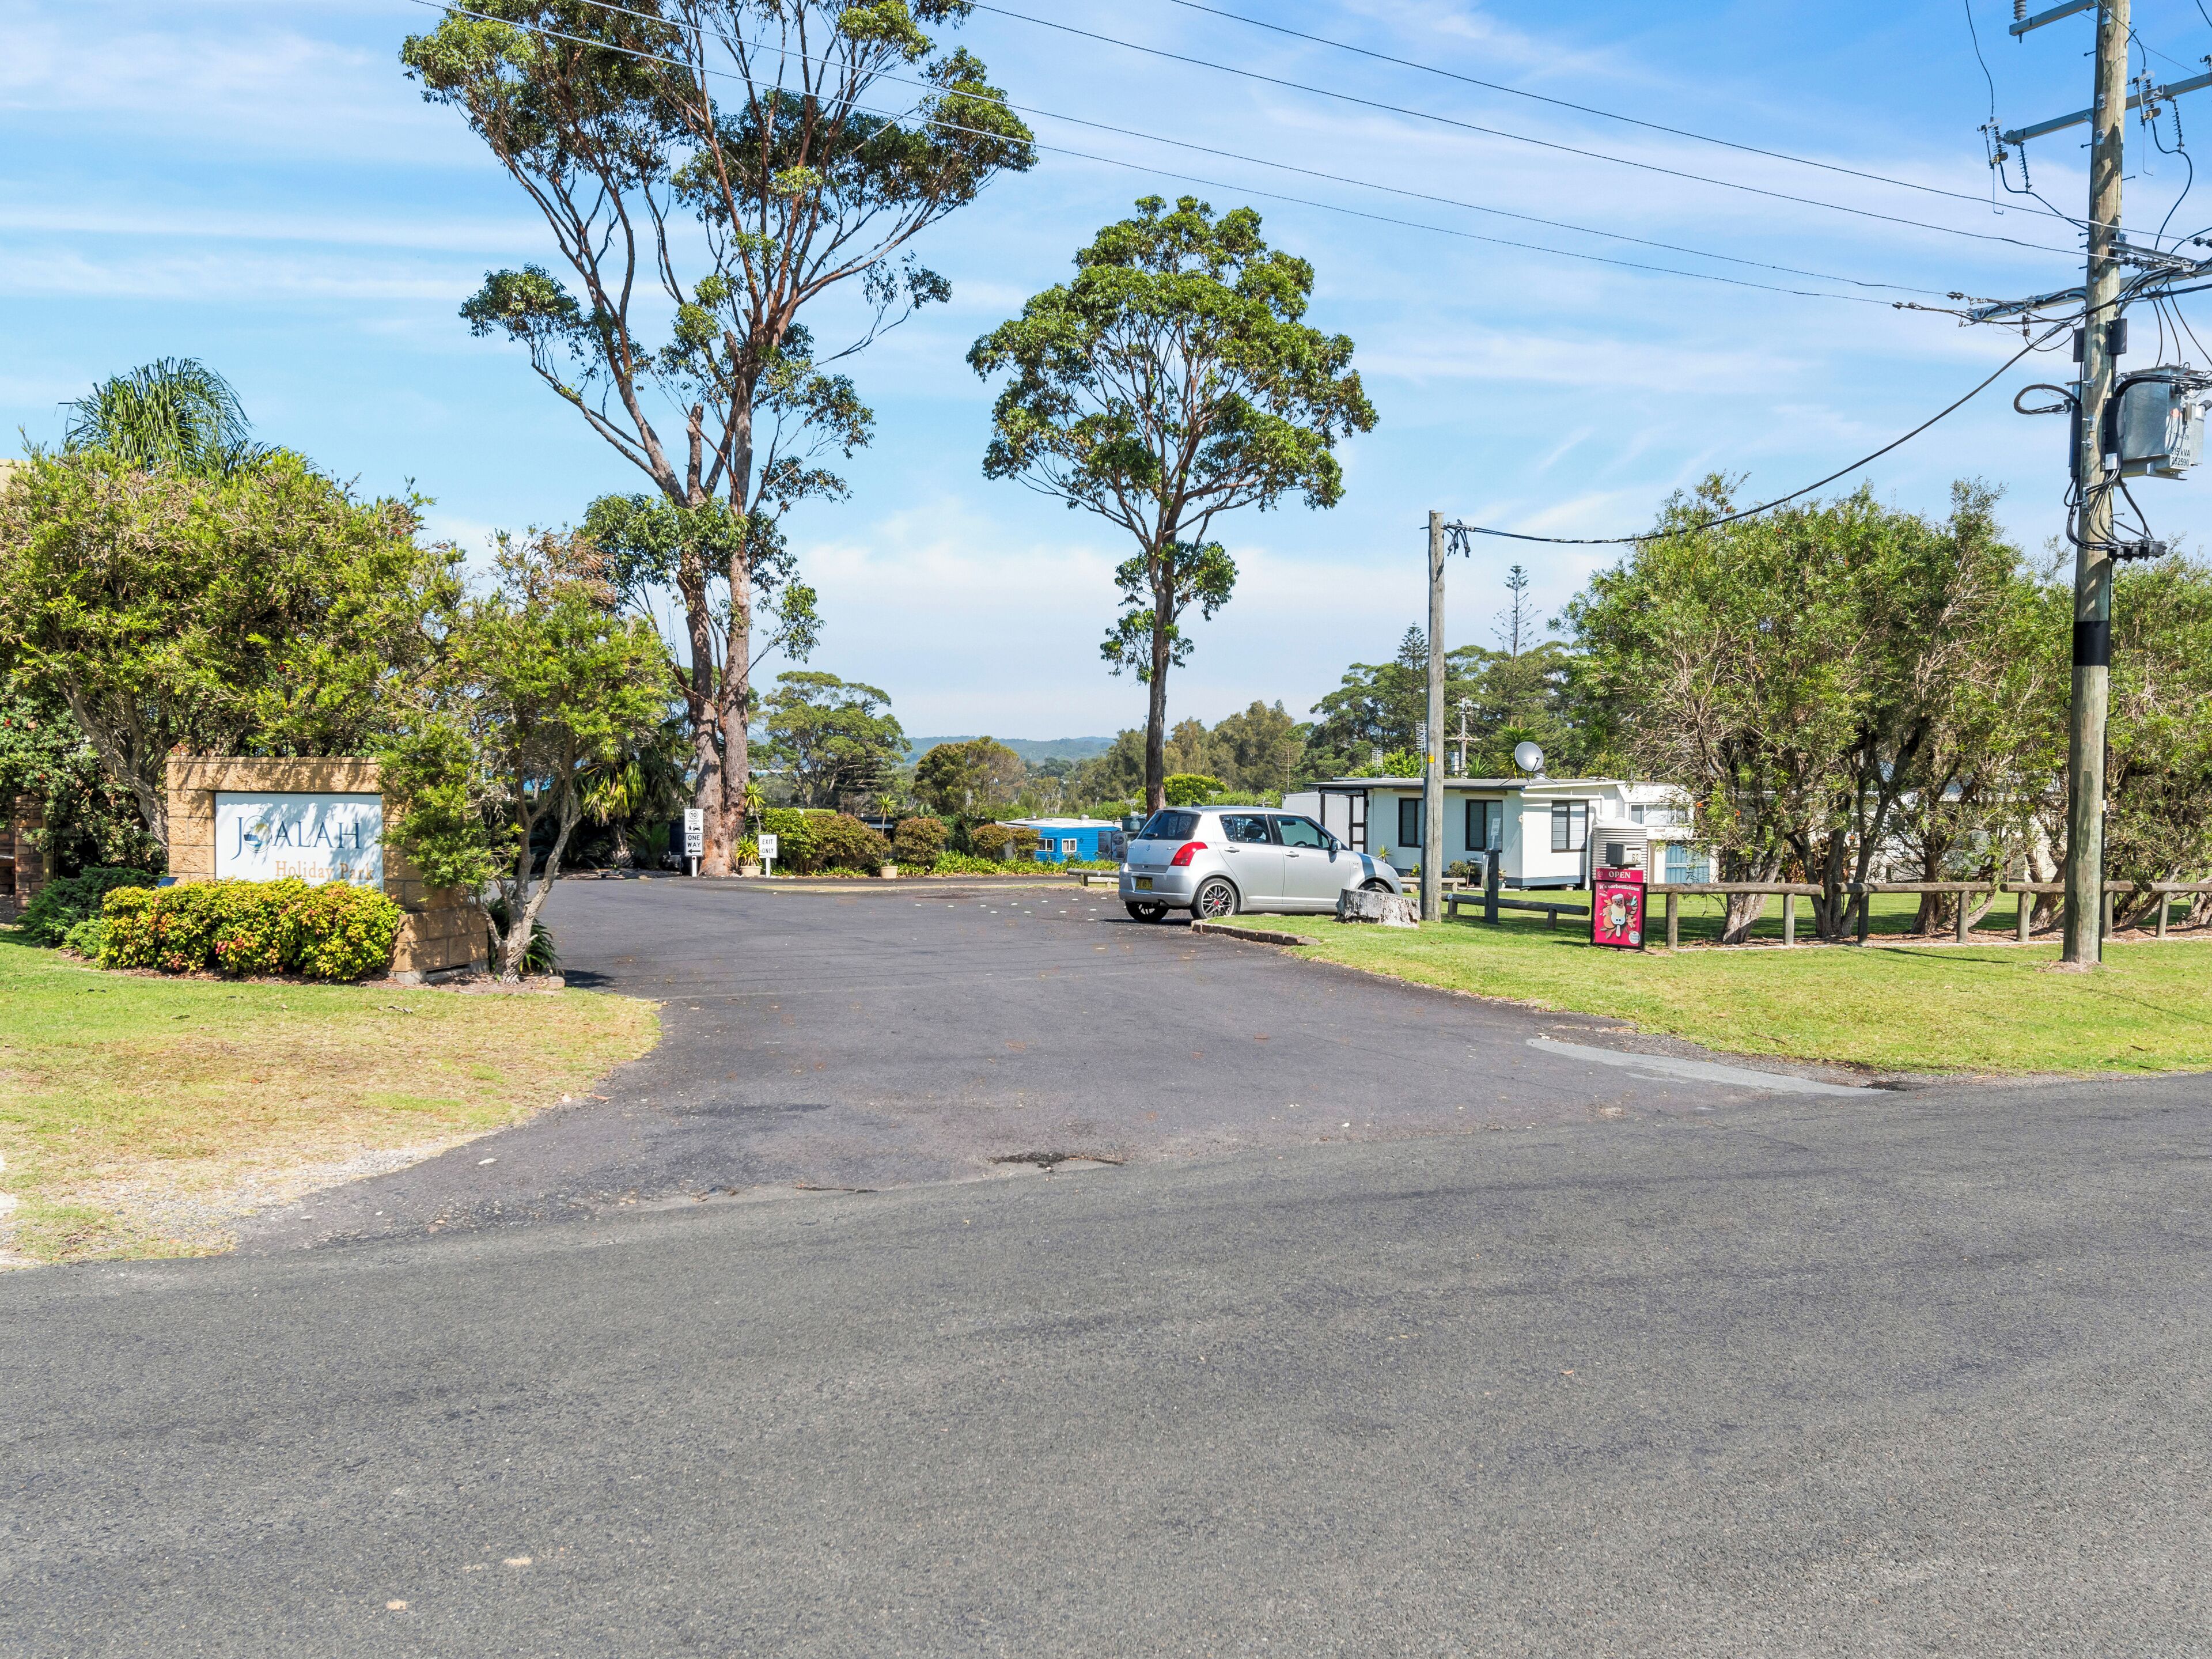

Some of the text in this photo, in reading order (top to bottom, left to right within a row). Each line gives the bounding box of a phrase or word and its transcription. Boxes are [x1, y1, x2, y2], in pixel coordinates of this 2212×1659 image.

[2181, 449, 2190, 457] kVA
[231, 815, 362, 861] JOALAH
[1631, 853, 1639, 862] 62
[275, 861, 374, 881] Holiday Park
[1608, 870, 1631, 879] OPEN
[1608, 884, 1640, 892] sorbetlicious
